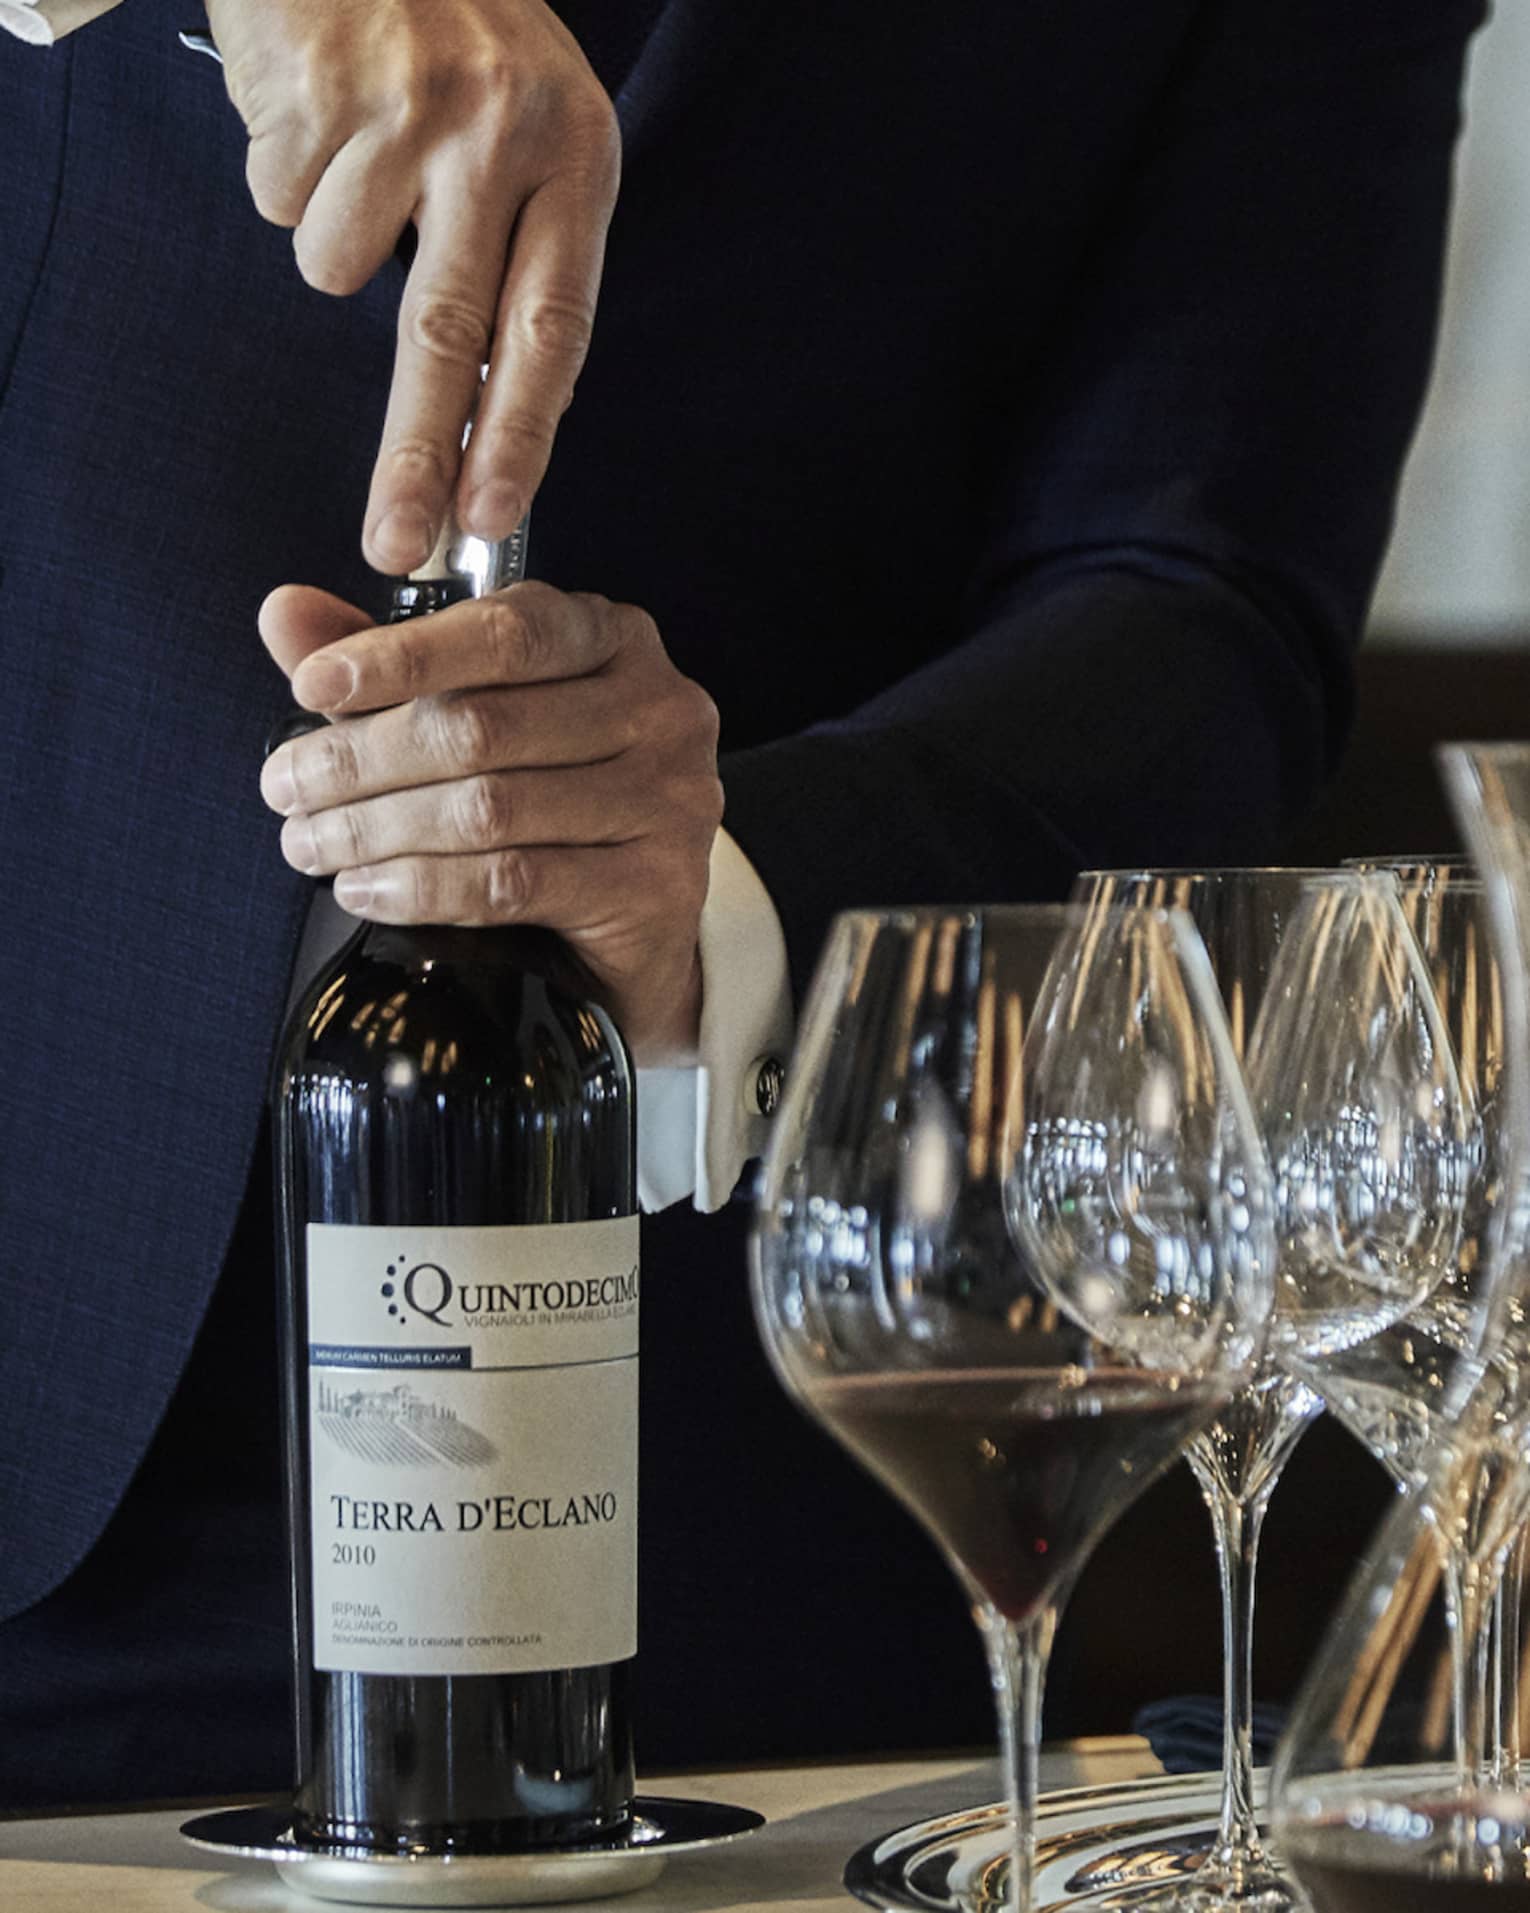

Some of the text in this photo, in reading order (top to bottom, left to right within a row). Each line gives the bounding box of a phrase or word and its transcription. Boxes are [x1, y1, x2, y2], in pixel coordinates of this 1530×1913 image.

[539, 1312, 552, 1326] IN
[331, 1492, 616, 1532] TERRA D'ECLANO
[332, 1543, 376, 1565] 2010
[332, 1602, 381, 1617] IRPINIA
[407, 1637, 418, 1648] DI
[467, 1634, 541, 1648] CONTROLLATA
